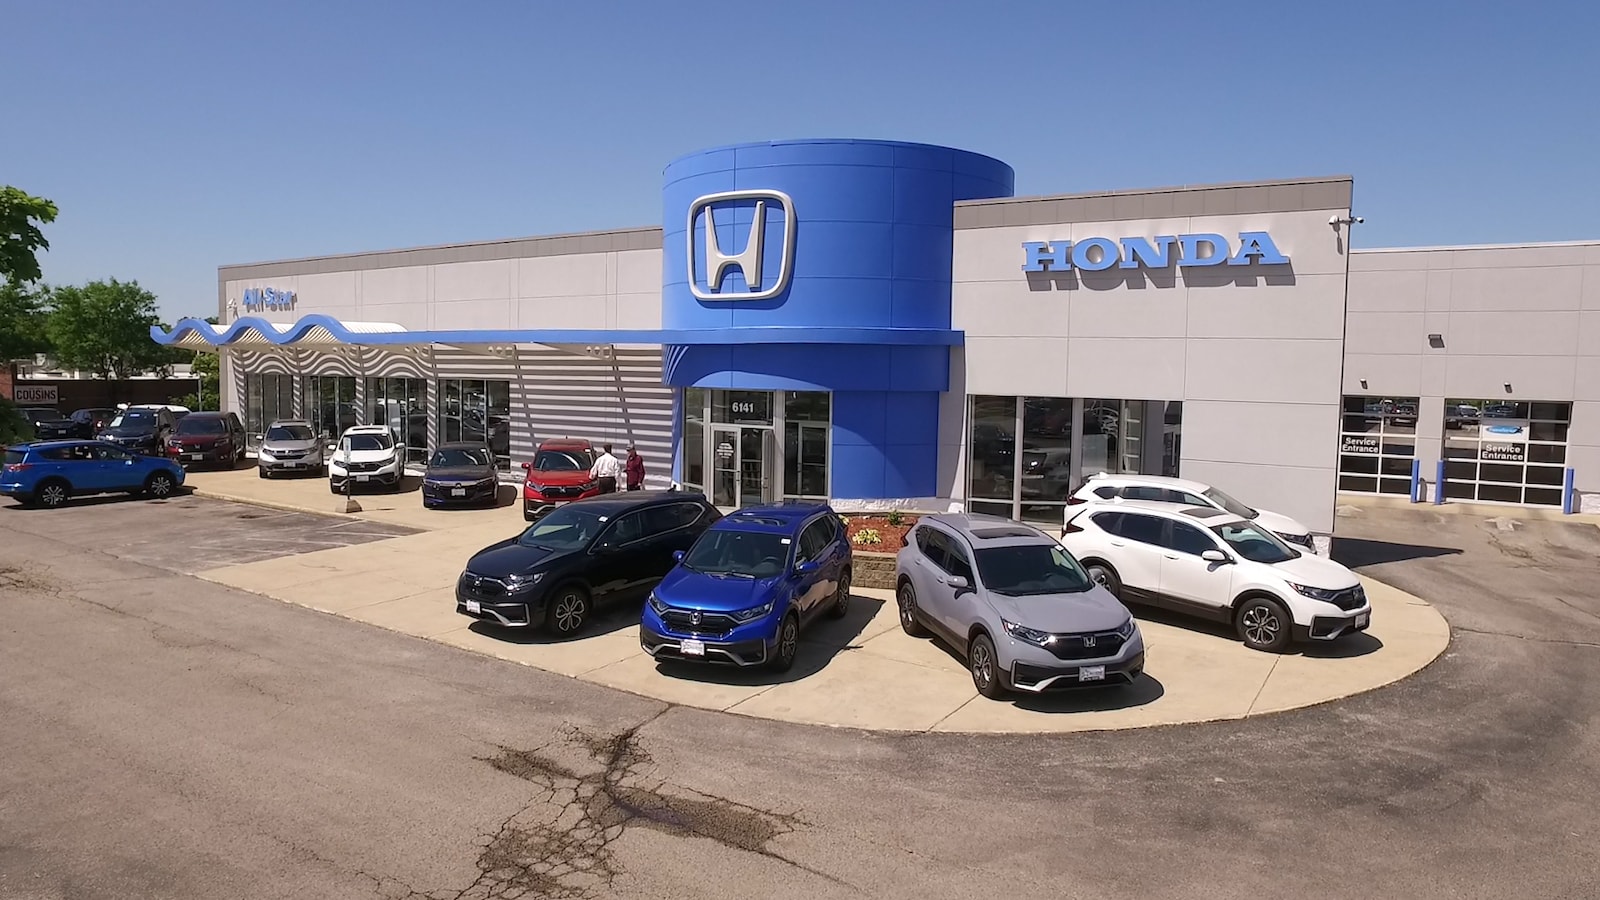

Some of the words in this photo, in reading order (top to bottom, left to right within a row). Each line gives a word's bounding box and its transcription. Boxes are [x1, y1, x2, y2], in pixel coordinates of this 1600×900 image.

[1021, 231, 1290, 272] HONDA
[16, 390, 56, 400] COUSINS
[732, 402, 754, 413] 6141
[1345, 437, 1376, 446] Service
[1342, 444, 1379, 453] Entrance
[1485, 444, 1521, 453] Service
[1481, 451, 1524, 461] Entrance
